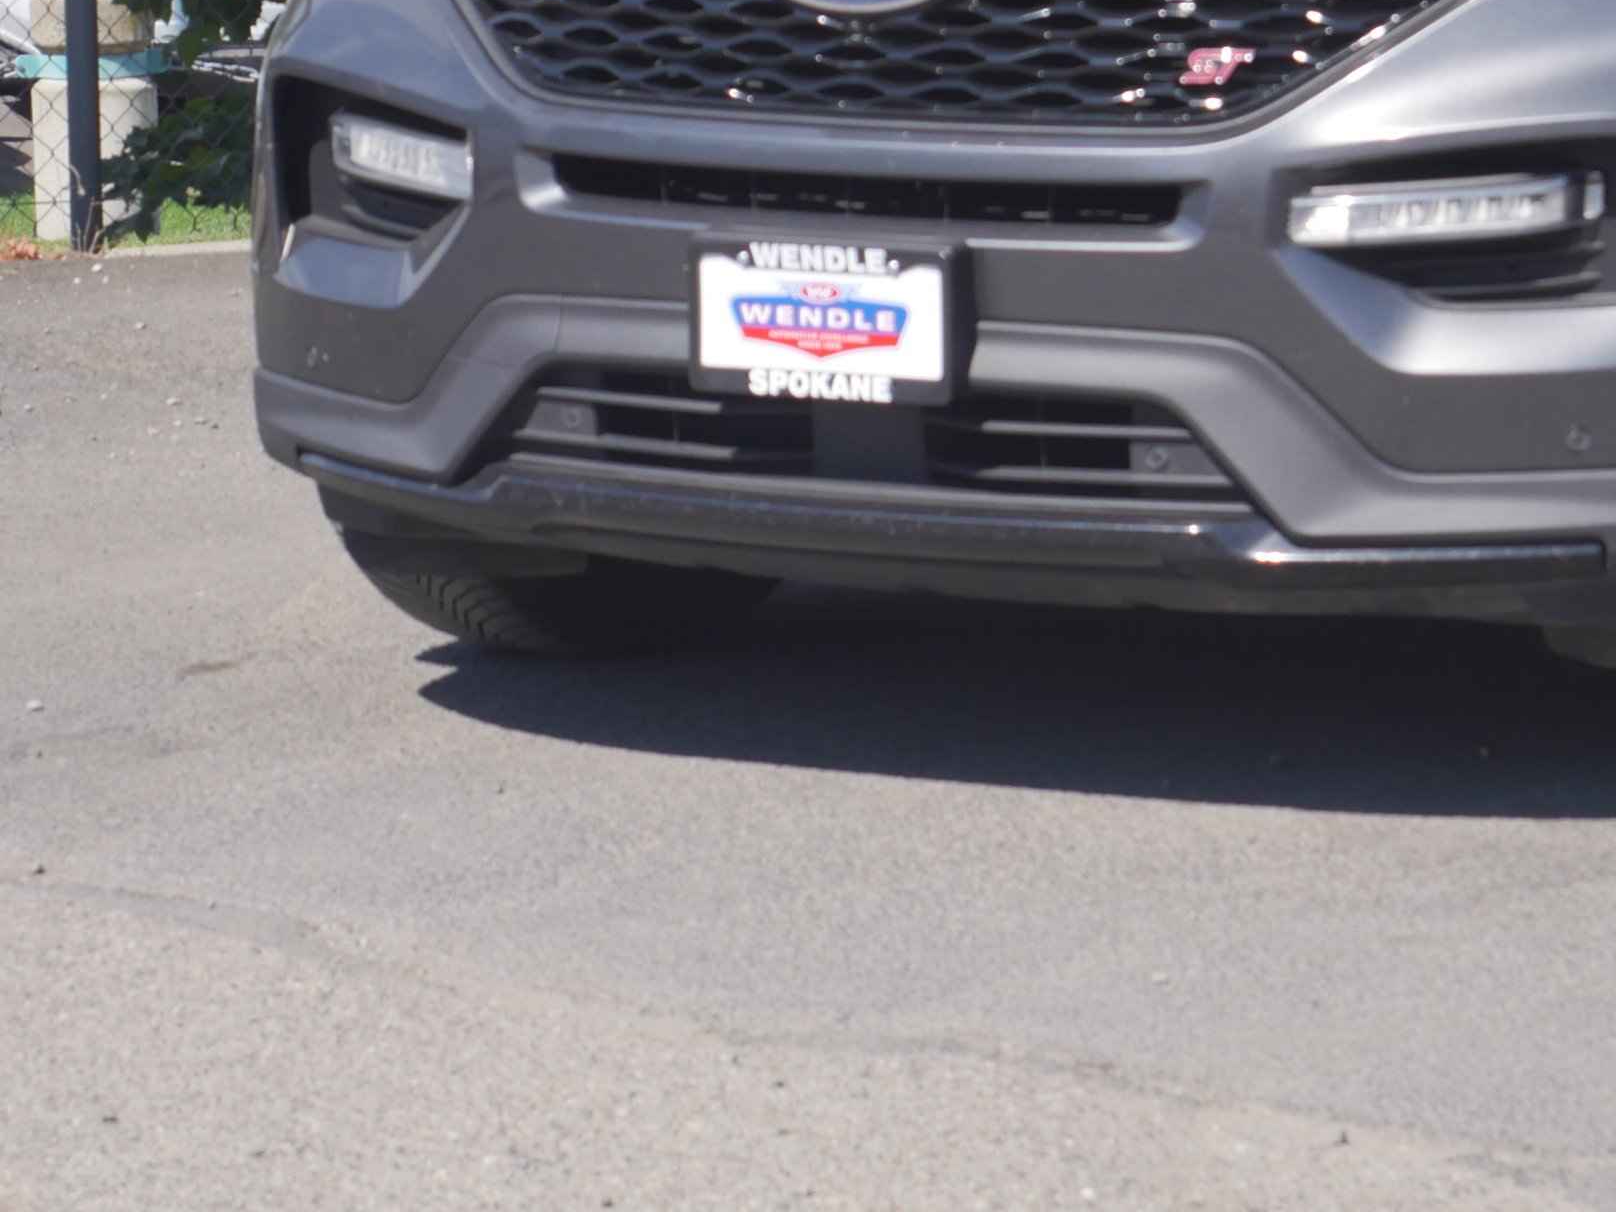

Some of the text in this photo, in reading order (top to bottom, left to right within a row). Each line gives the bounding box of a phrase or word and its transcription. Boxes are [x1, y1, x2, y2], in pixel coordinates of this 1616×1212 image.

[749, 241, 888, 275] WENDLE
[739, 302, 897, 333] WENDLE
[749, 368, 893, 404] SPOKANE
